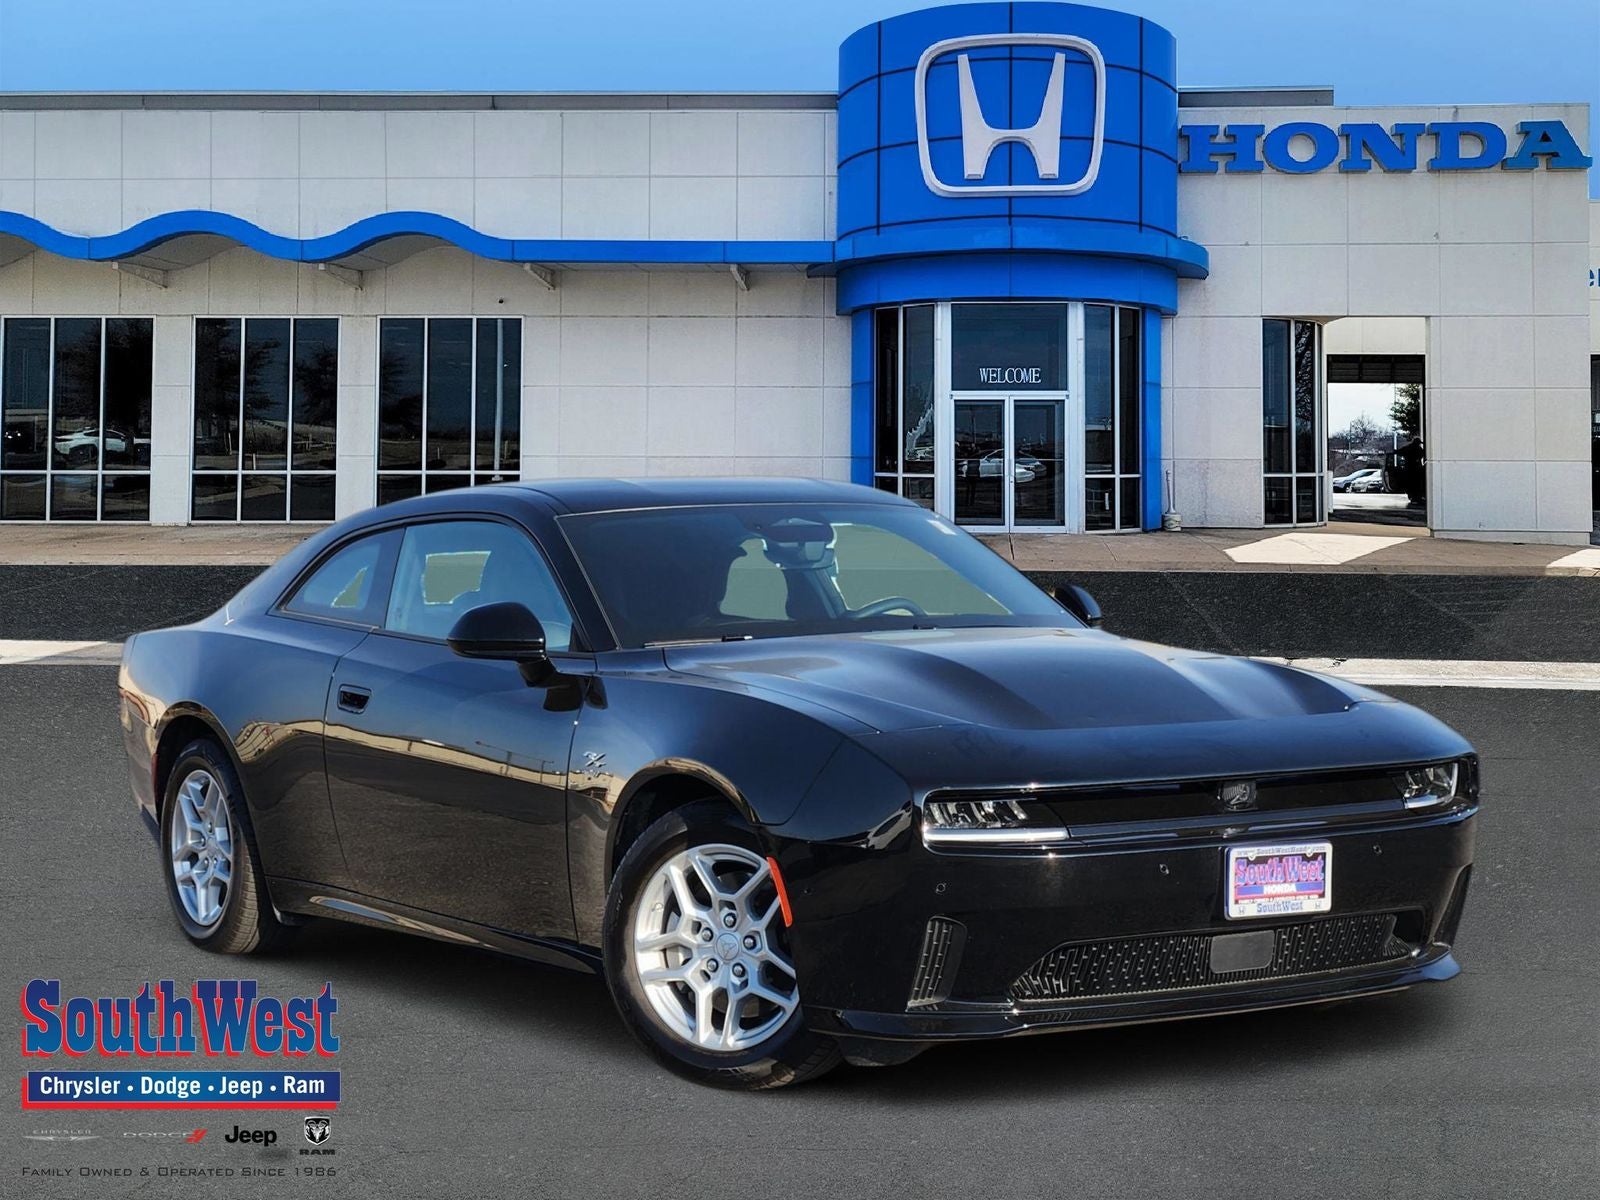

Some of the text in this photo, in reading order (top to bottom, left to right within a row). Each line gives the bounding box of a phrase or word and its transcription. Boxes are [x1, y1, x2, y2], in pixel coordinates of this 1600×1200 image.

[1179, 121, 1593, 174] HONDA
[979, 367, 1041, 383] WELCOME
[1234, 855, 1325, 886] SouthWest
[1256, 901, 1304, 913] SouthWest
